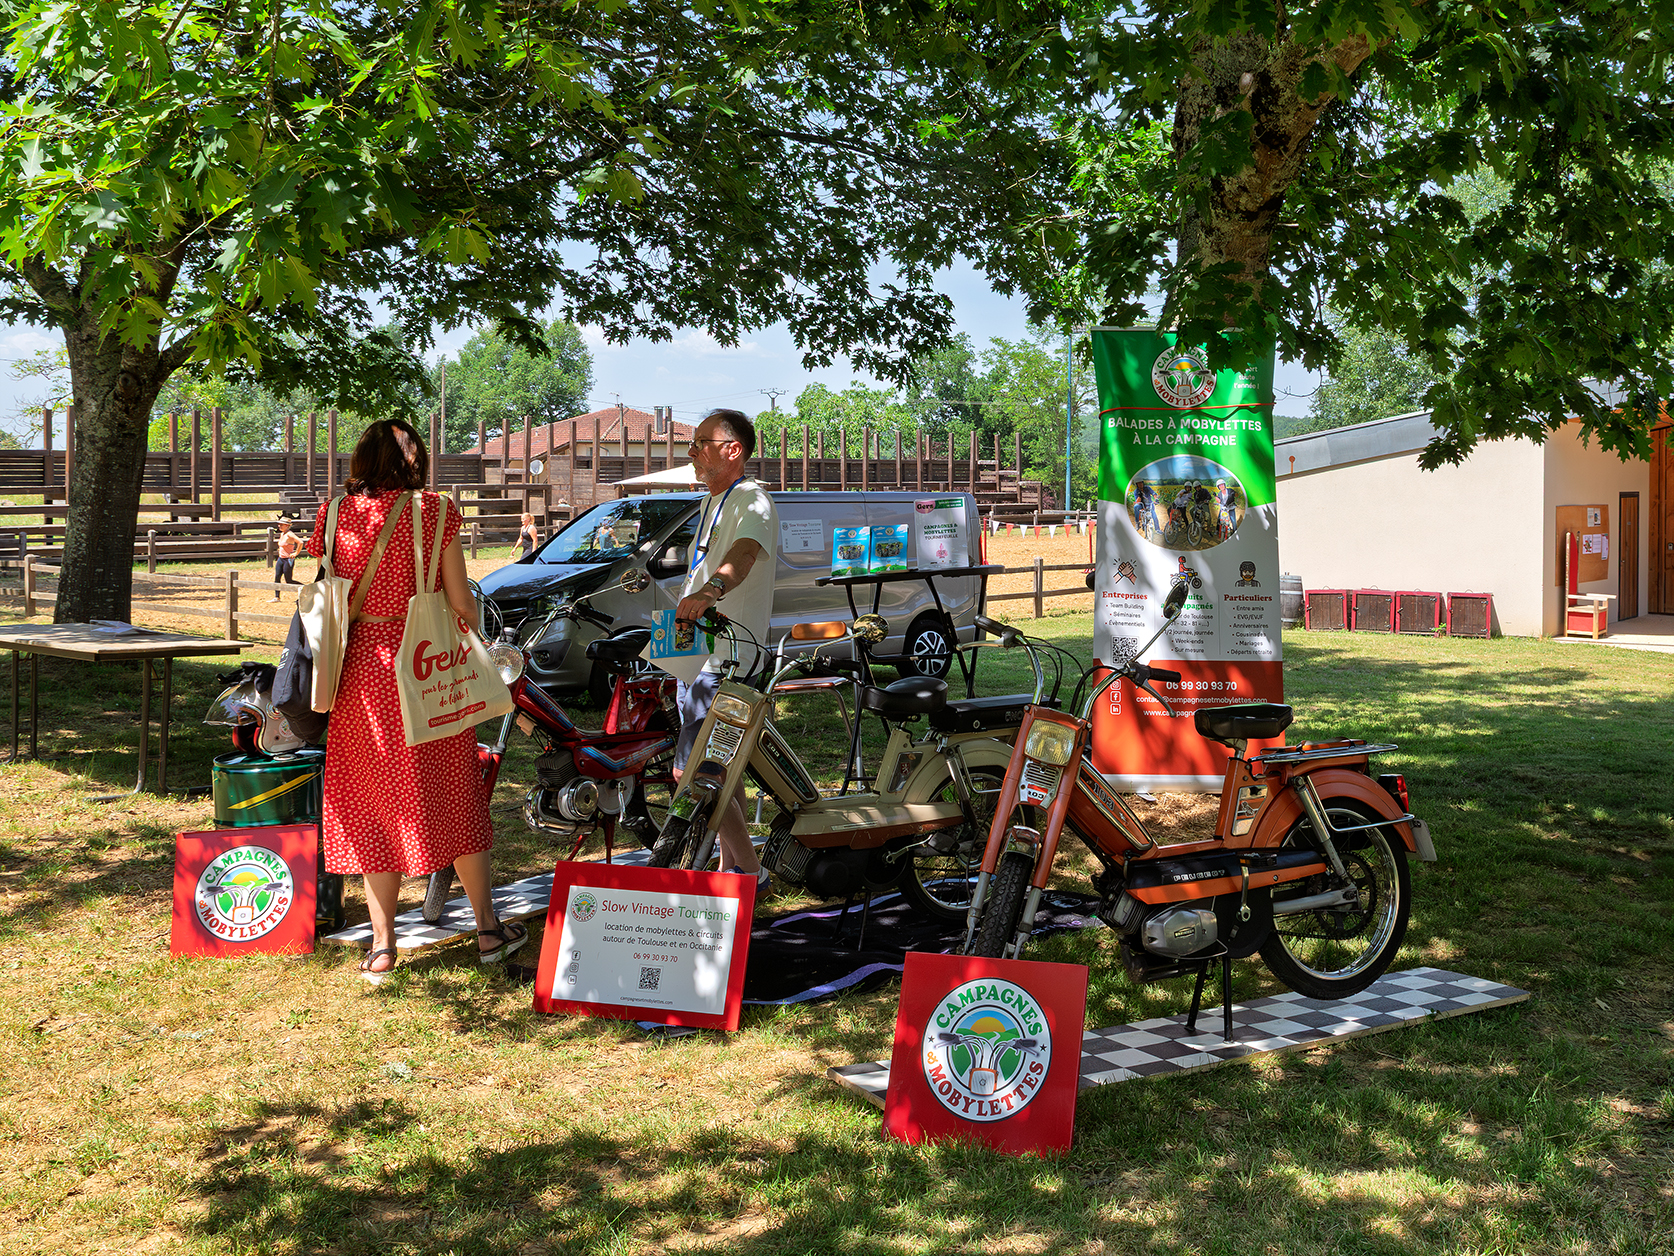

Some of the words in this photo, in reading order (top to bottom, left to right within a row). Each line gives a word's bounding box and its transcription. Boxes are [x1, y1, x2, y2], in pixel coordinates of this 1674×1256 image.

[1156, 379, 1214, 406] MOBYLETTES
[1108, 417, 1163, 430] BALADES
[1167, 416, 1177, 430] À
[1180, 418, 1262, 432] MOBYLETTES
[1132, 431, 1142, 445] À
[1145, 434, 1162, 446] LA
[1165, 434, 1237, 446] CAMPAGNE
[1102, 590, 1148, 600] Entreprises
[1223, 594, 1273, 602] Particuliers
[1124, 603, 1145, 611] Building
[1230, 648, 1252, 656] Départs
[413, 640, 473, 681] Gers
[1166, 681, 1179, 690] 06
[1181, 681, 1194, 690] 99
[1195, 681, 1209, 690] 30
[1210, 681, 1224, 690] 93
[1225, 681, 1238, 690] 70
[1027, 790, 1044, 800] 103
[1093, 782, 1115, 811] 103
[205, 849, 287, 884] CAMPAGNES
[1173, 869, 1225, 882] PEUGEOT
[198, 899, 208, 909] &
[601, 900, 628, 913] Slow
[631, 902, 674, 919] Vintage
[678, 905, 731, 922] Tourisme
[200, 896, 289, 939] MOBYLETTES
[604, 922, 634, 932] location
[634, 924, 645, 933] de
[645, 926, 687, 937] mobylettes
[687, 928, 695, 937] &
[695, 929, 724, 940] circuits
[602, 935, 625, 943] autour
[626, 936, 636, 945] de
[637, 936, 668, 947] Toulouse
[669, 940, 677, 948] et
[689, 941, 723, 952] Occitanie
[633, 952, 641, 960] 06
[642, 952, 651, 961] 99
[651, 953, 660, 961] 30
[660, 954, 669, 962] 93
[670, 955, 679, 963] 70
[936, 984, 1043, 1036] CAMPAGNES
[926, 1050, 939, 1065] &
[928, 1060, 1044, 1117] MOBYLETTES
